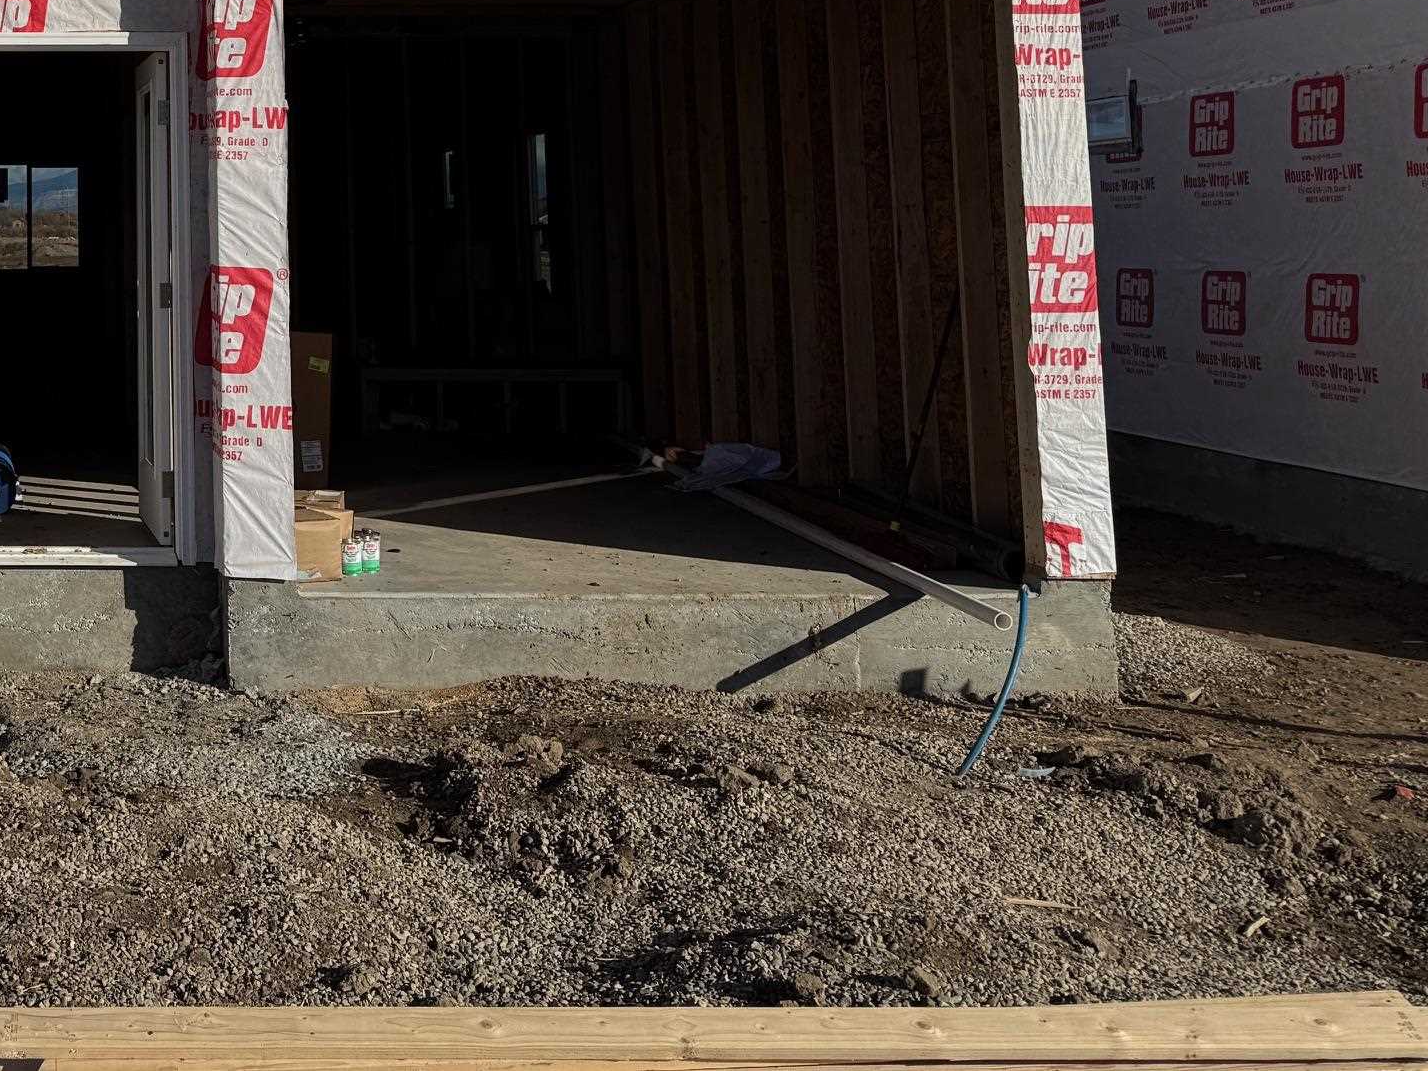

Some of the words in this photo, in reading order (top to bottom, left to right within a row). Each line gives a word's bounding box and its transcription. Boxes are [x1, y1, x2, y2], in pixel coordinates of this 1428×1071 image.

[1020, 89, 1048, 98] ASTM
[1058, 89, 1081, 97] 2357
[1297, 82, 1339, 113] Grip
[1194, 97, 1229, 126] Grip
[228, 137, 255, 146] Grade
[1195, 126, 1229, 153] Rite
[1298, 114, 1337, 143] Rite
[226, 151, 248, 160] 2357
[1285, 163, 1364, 184] House-Wrap-LWE
[1027, 215, 1094, 263] rip
[1028, 263, 1088, 304] ite
[1207, 276, 1241, 306] Grip
[1312, 278, 1353, 312] Grip
[1121, 300, 1148, 323] Rite
[1208, 305, 1239, 330] Rite
[1312, 311, 1351, 338] Rite
[1297, 360, 1379, 384] House-Wrap-LWE
[1073, 389, 1096, 398] 2357
